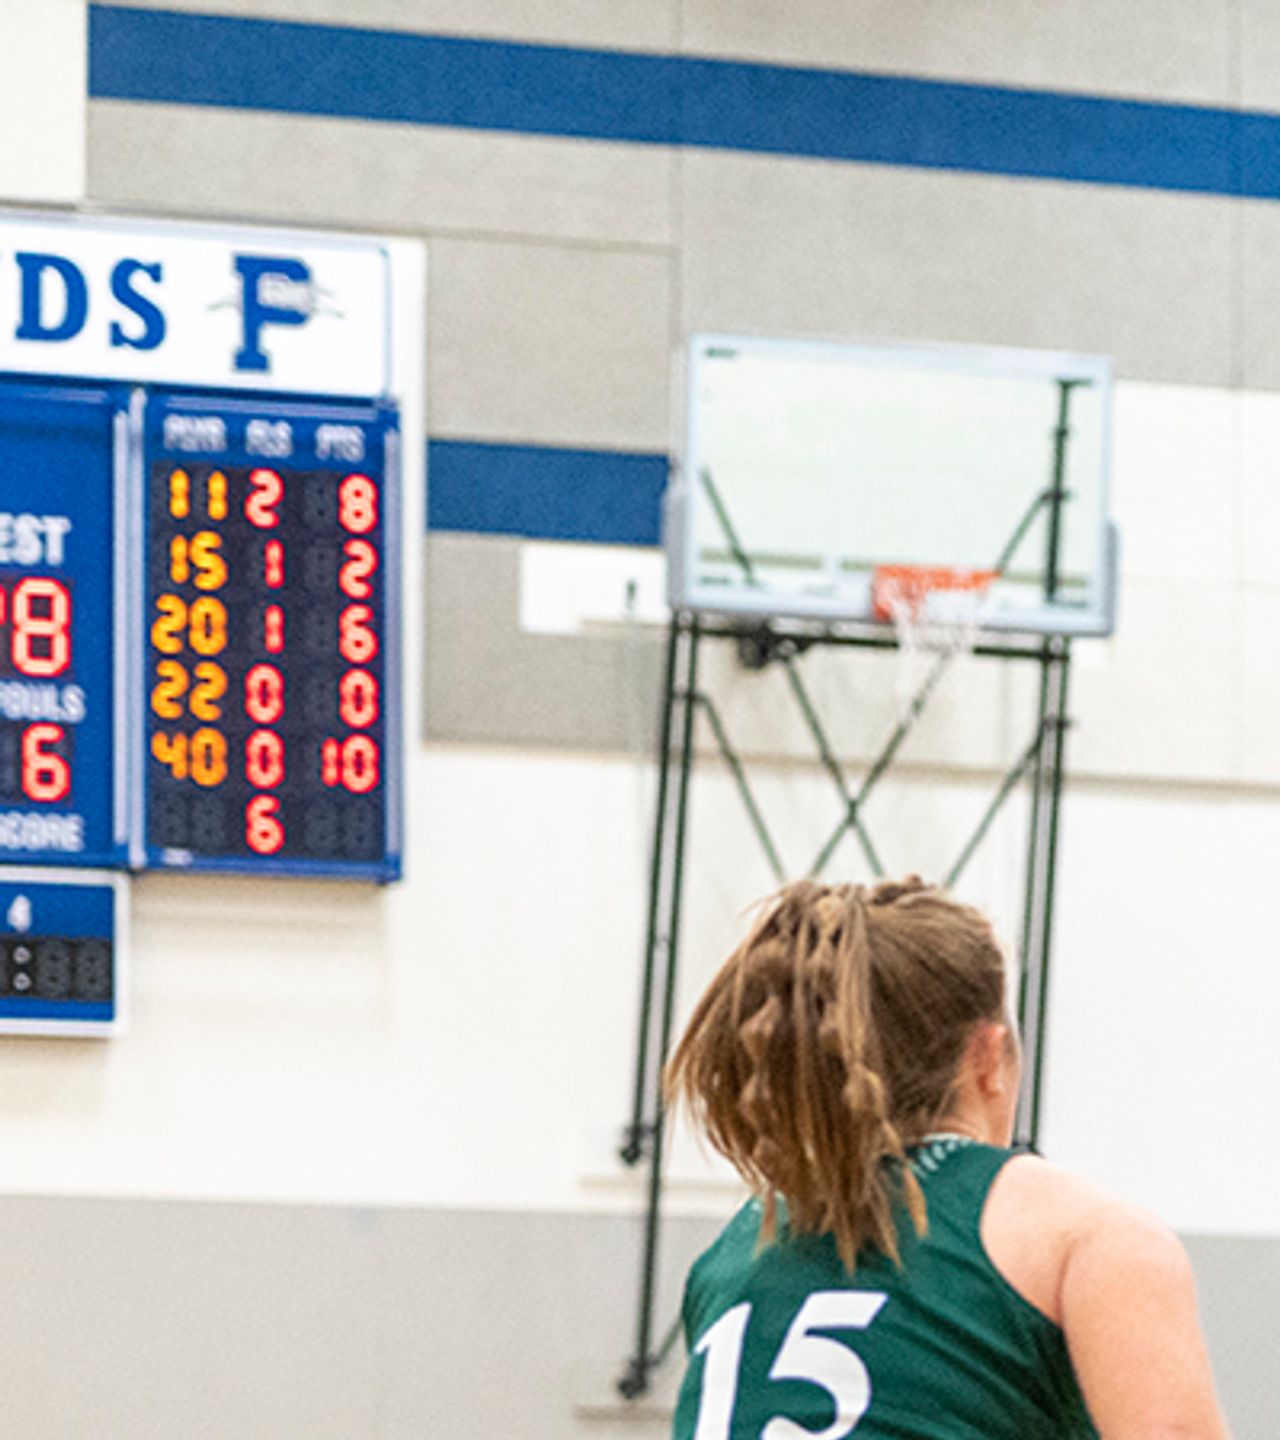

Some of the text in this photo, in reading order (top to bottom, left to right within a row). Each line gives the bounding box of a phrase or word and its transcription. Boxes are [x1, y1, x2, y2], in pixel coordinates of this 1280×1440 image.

[14, 250, 168, 351] DS
[169, 468, 379, 535] 11 2 8
[169, 530, 379, 600] 15 1 2
[0, 574, 72, 679] 8
[150, 593, 380, 665] 20 1 6
[0, 680, 87, 725] OULS
[150, 659, 380, 730] 22 0 0
[22, 720, 72, 804] 6
[151, 727, 380, 794] 40 0 10
[0, 810, 85, 852] CORE
[244, 792, 286, 855] 6
